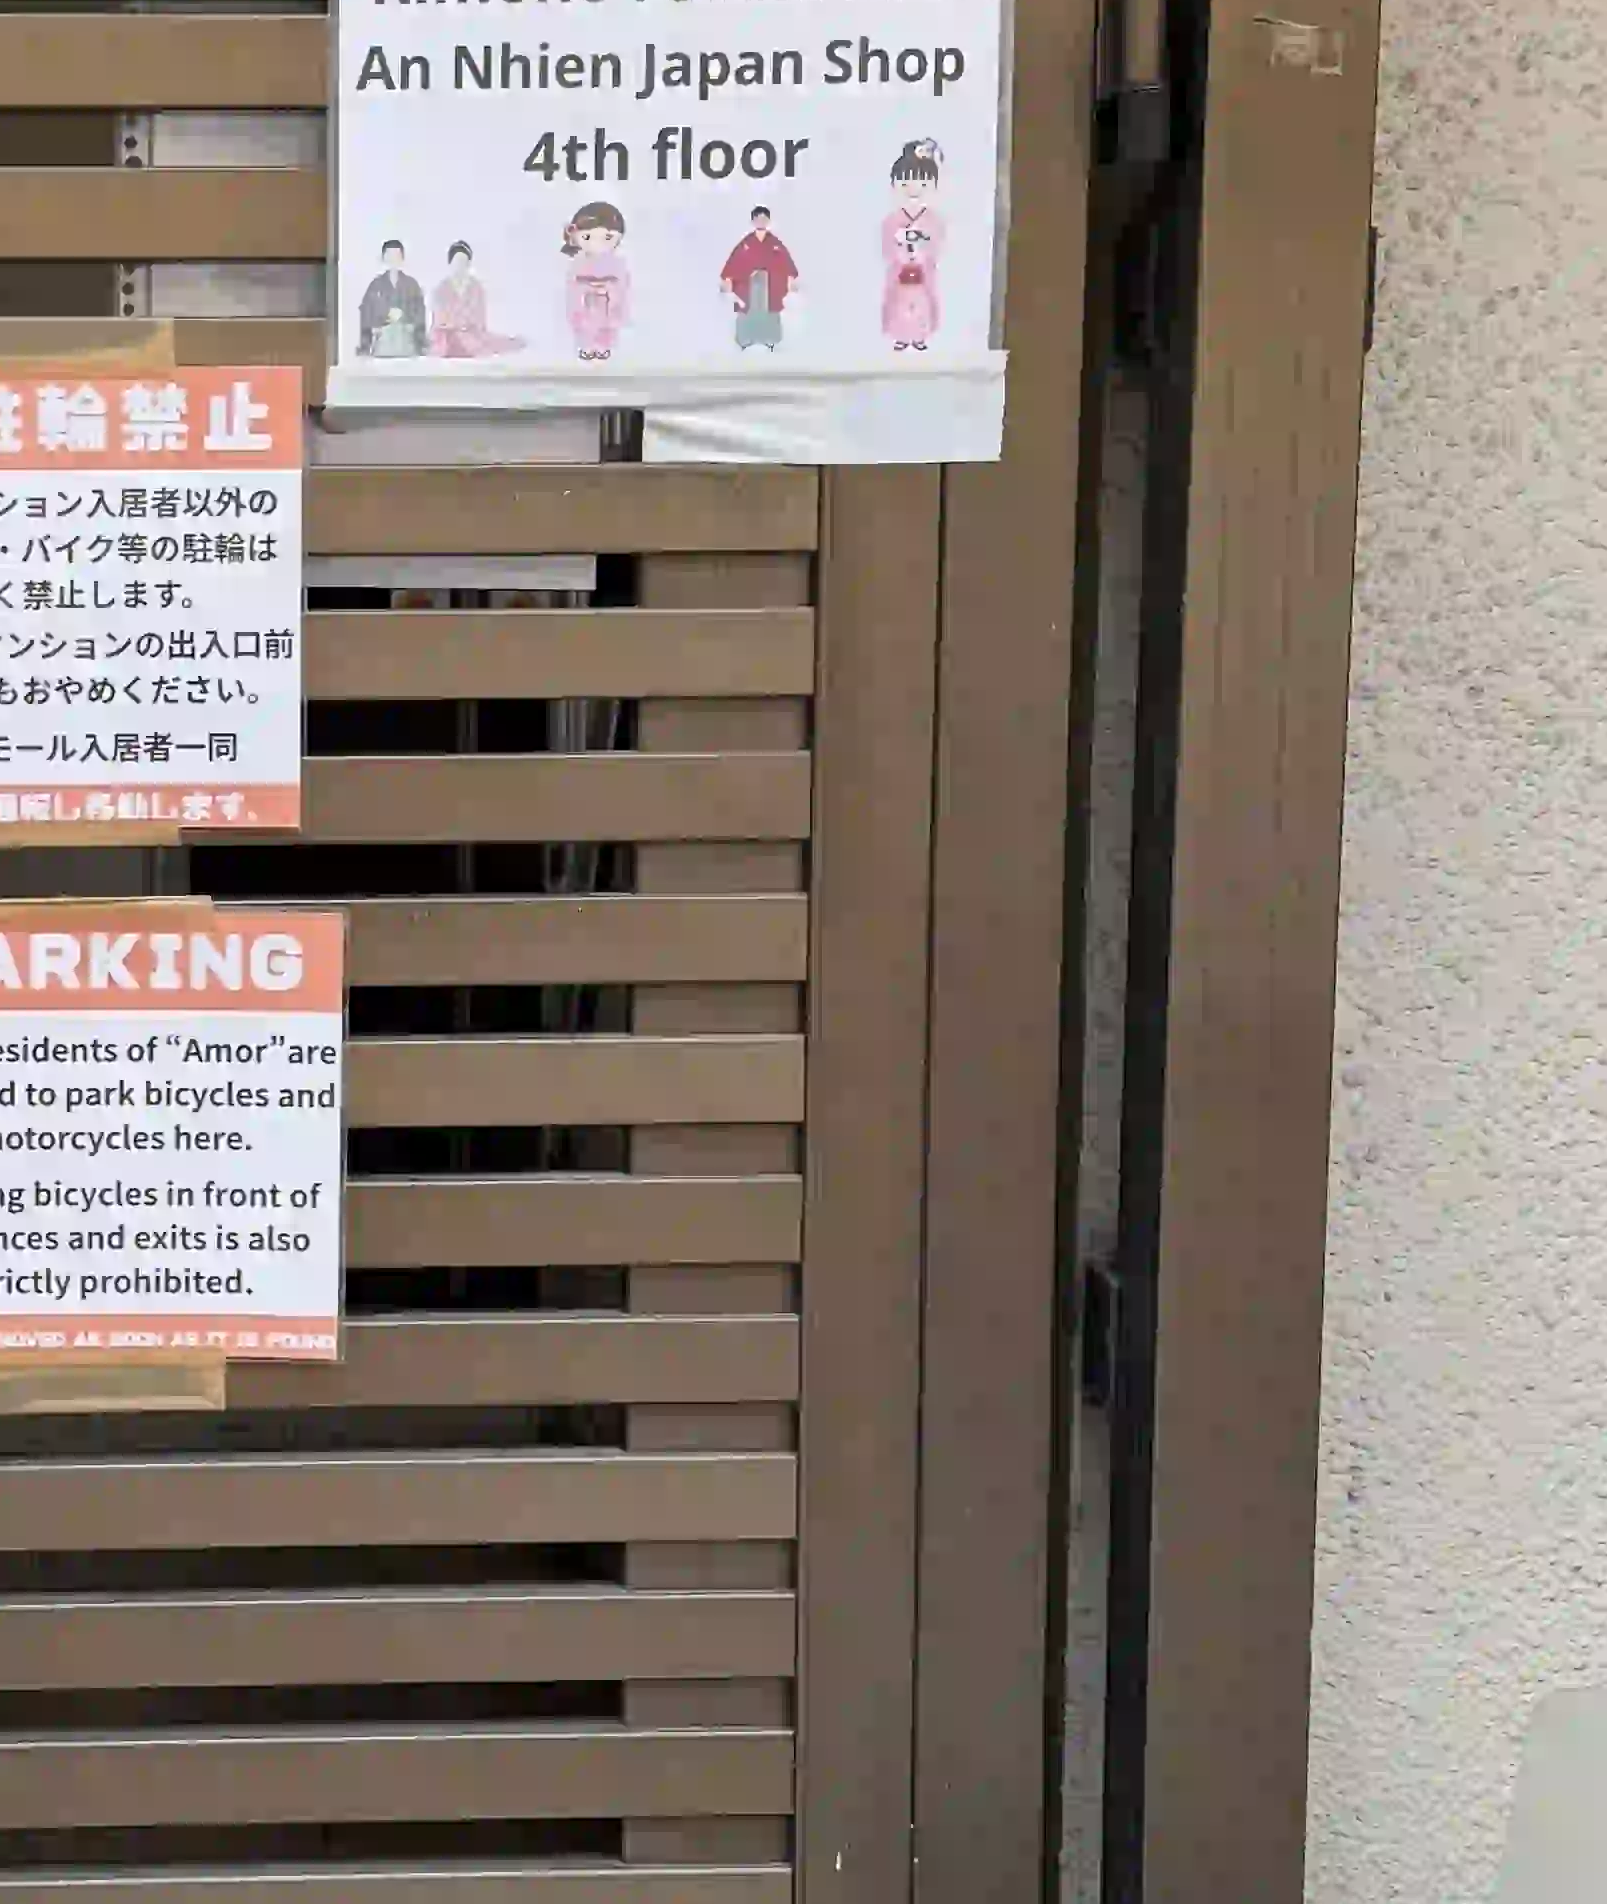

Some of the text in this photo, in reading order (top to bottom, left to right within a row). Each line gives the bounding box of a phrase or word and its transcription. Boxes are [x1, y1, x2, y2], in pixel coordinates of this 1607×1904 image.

[355, 35, 965, 101] An Nhien Japan Shop
[523, 126, 809, 182] 4th floor
[126, 1035, 159, 1063] of
[25, 1083, 57, 1107] to
[66, 1079, 135, 1113] park
[145, 1080, 270, 1113] bicycles
[278, 1082, 335, 1109] and
[173, 1123, 252, 1151] here.
[33, 1179, 158, 1213] bicycles
[166, 1180, 194, 1207] in
[202, 1180, 282, 1208] front
[289, 1182, 323, 1209] of
[68, 1223, 125, 1251] and
[134, 1223, 207, 1251] exits
[216, 1224, 239, 1251] is
[248, 1224, 311, 1252] also
[80, 1267, 253, 1301] prohibited.
